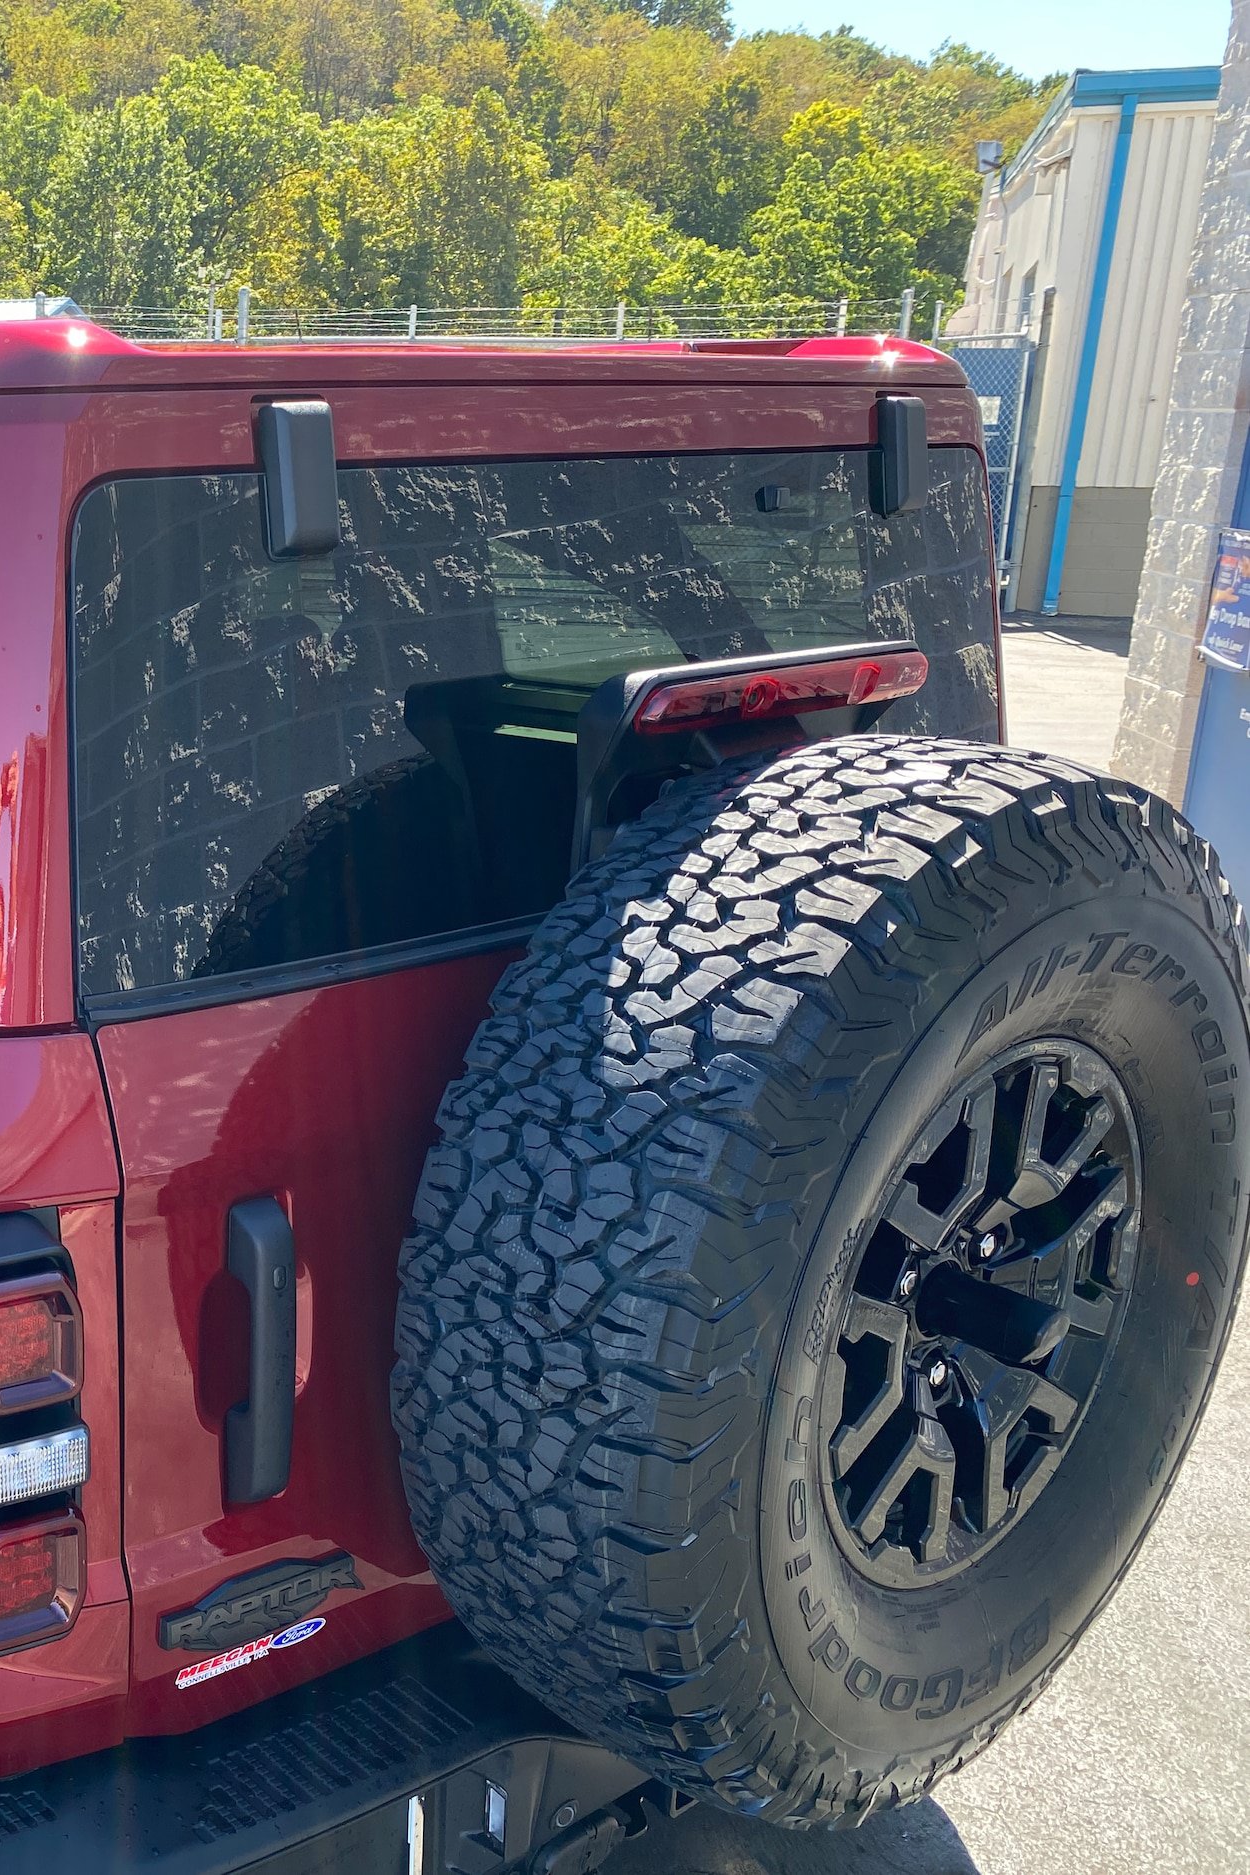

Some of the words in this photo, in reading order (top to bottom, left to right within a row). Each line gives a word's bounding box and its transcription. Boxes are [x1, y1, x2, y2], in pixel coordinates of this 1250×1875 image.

[955, 930, 1239, 1146] All-Terrain
[784, 1395, 1051, 1721] BFGoodrich
[170, 1559, 364, 1646] RAPTOR
[177, 1636, 271, 1681] MEEGAN
[281, 1625, 313, 1644] Ford
[254, 1649, 268, 1659] PA
